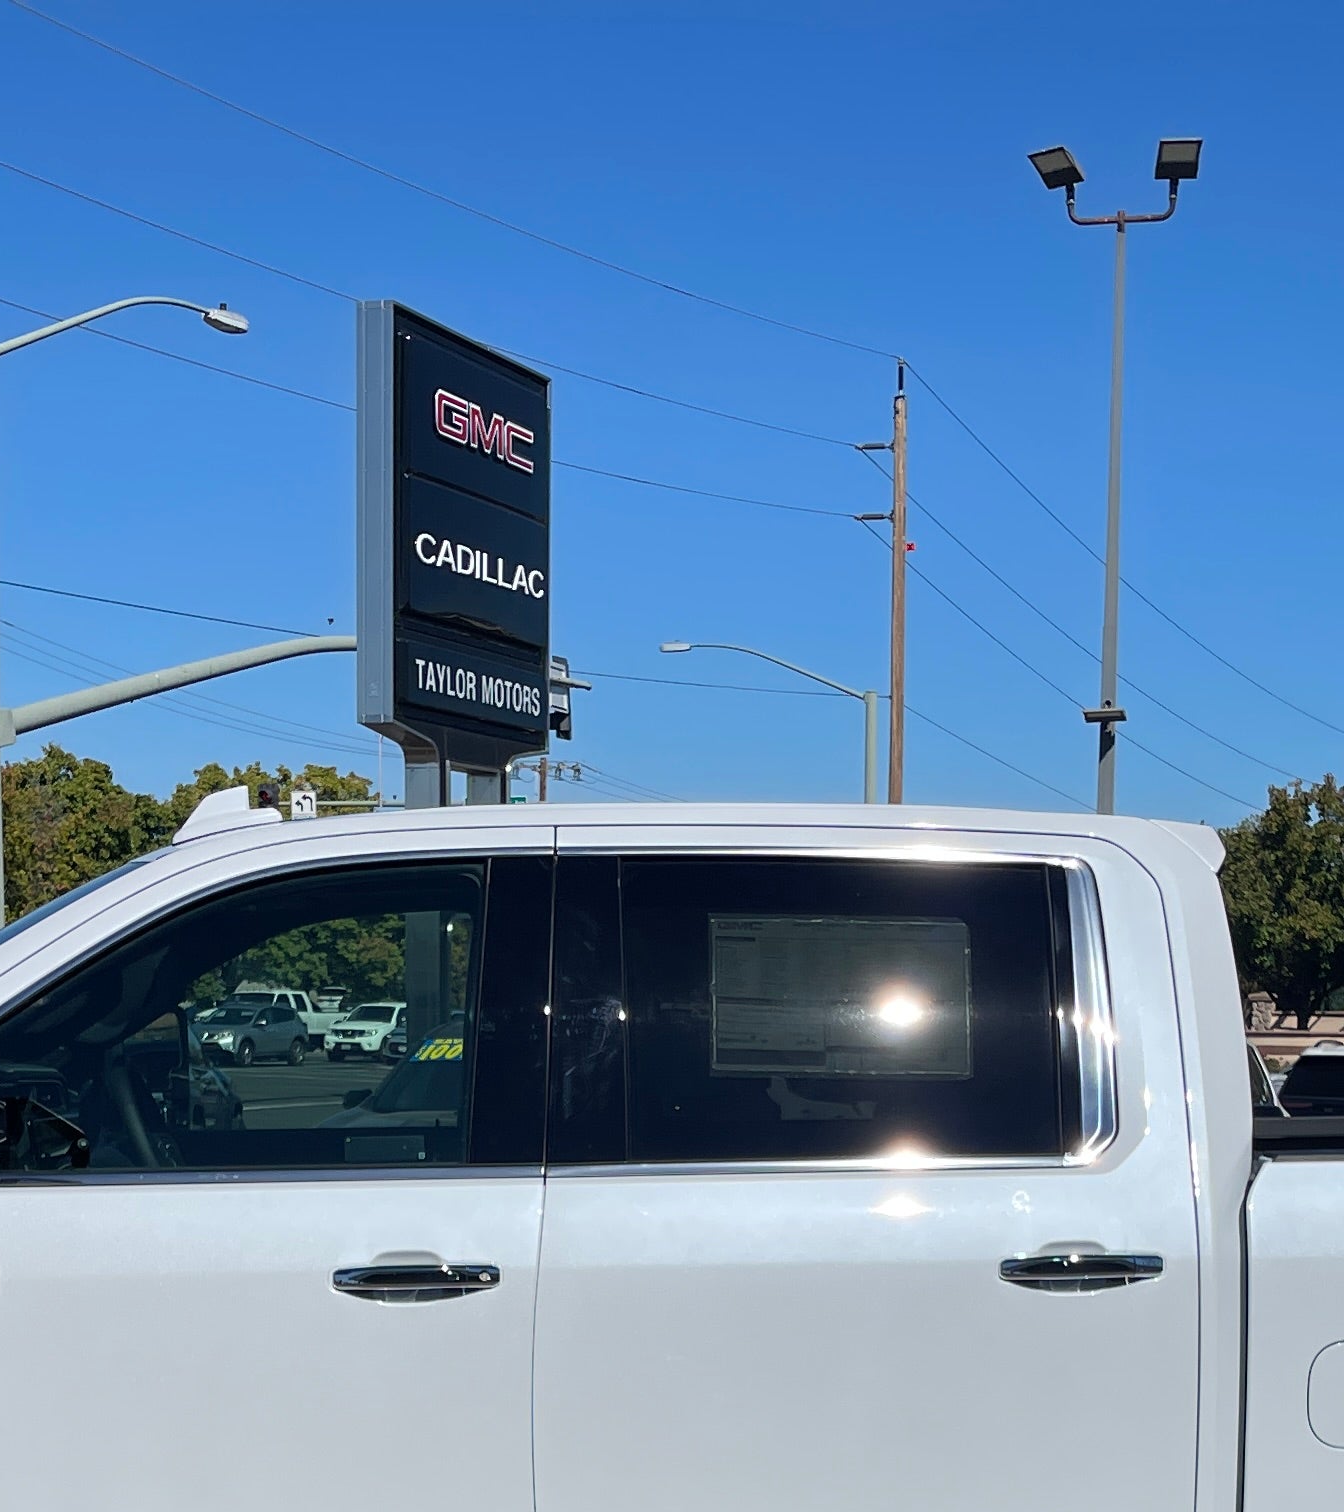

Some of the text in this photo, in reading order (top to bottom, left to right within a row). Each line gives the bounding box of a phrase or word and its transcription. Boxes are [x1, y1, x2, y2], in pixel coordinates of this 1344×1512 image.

[434, 388, 534, 474] GMC
[414, 533, 545, 599] CADILLAC
[415, 658, 541, 718] TAYLOR MOTORS
